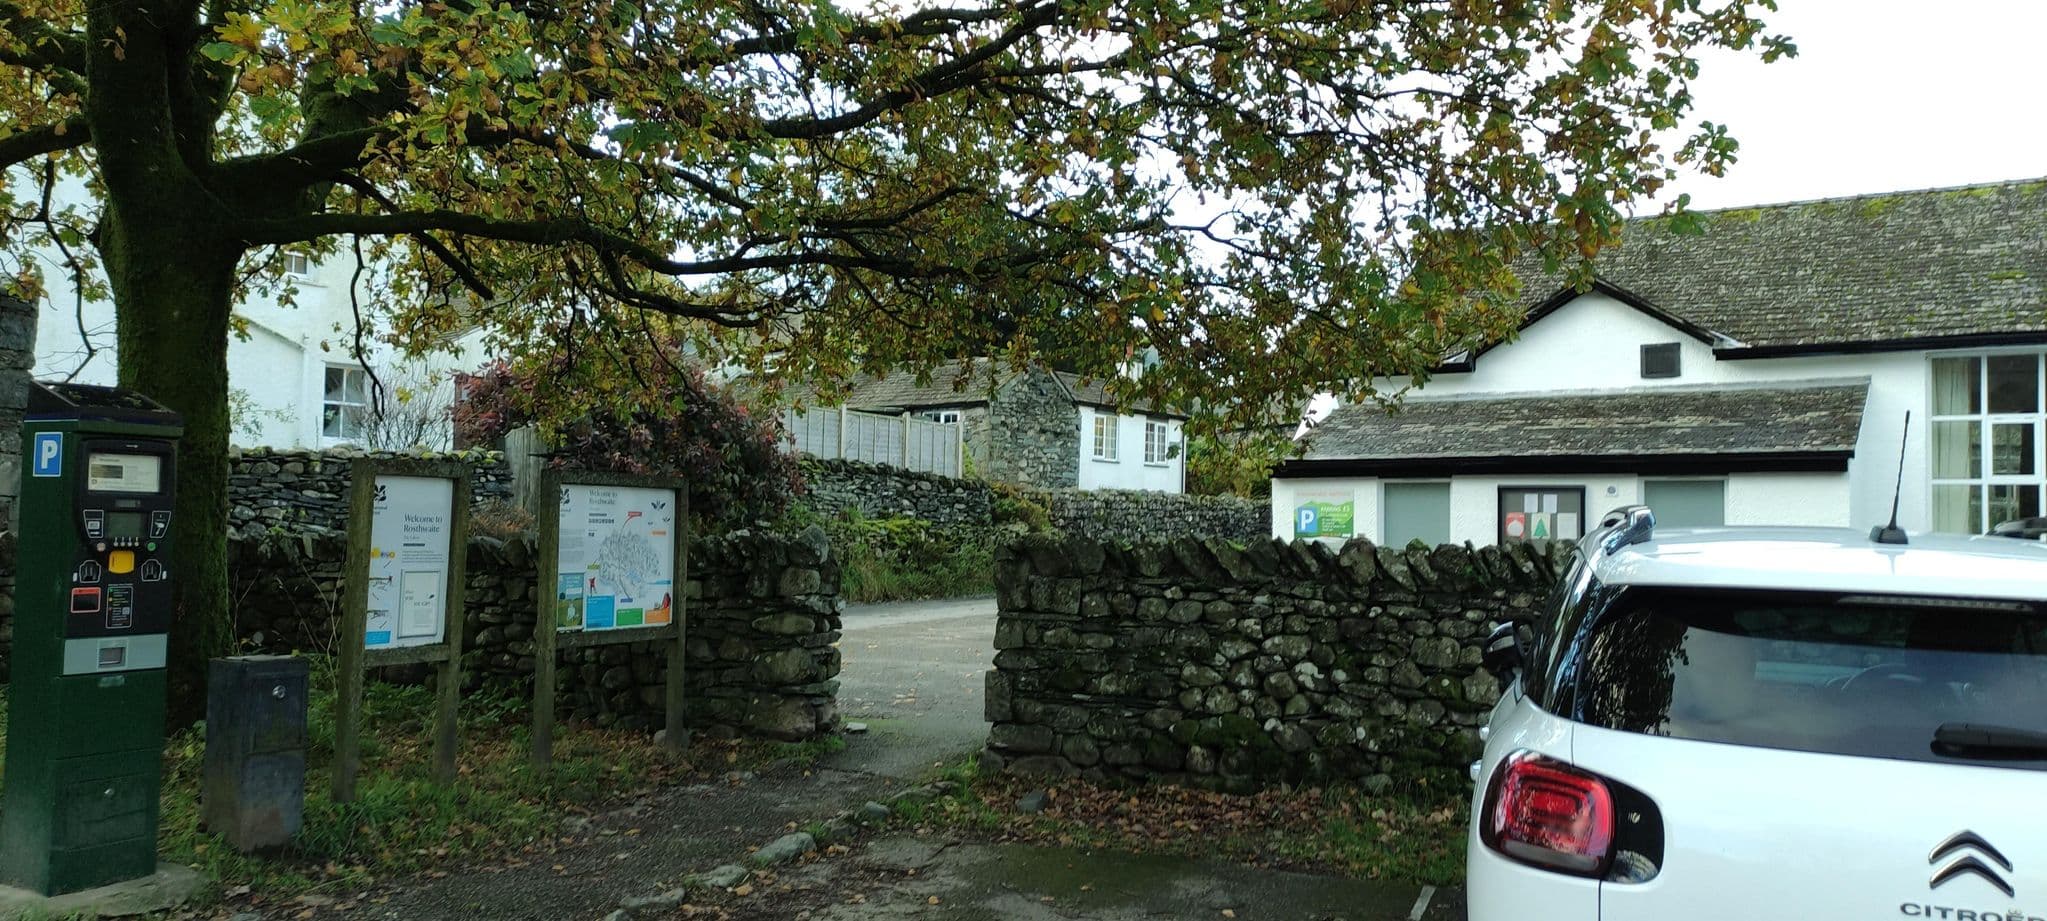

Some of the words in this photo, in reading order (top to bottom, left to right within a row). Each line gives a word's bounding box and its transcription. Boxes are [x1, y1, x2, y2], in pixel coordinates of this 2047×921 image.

[41, 440, 58, 469] P
[404, 513, 434, 523] Welcome
[435, 515, 443, 523] to
[1301, 509, 1315, 531] P
[403, 523, 440, 533] Rosthwaite
